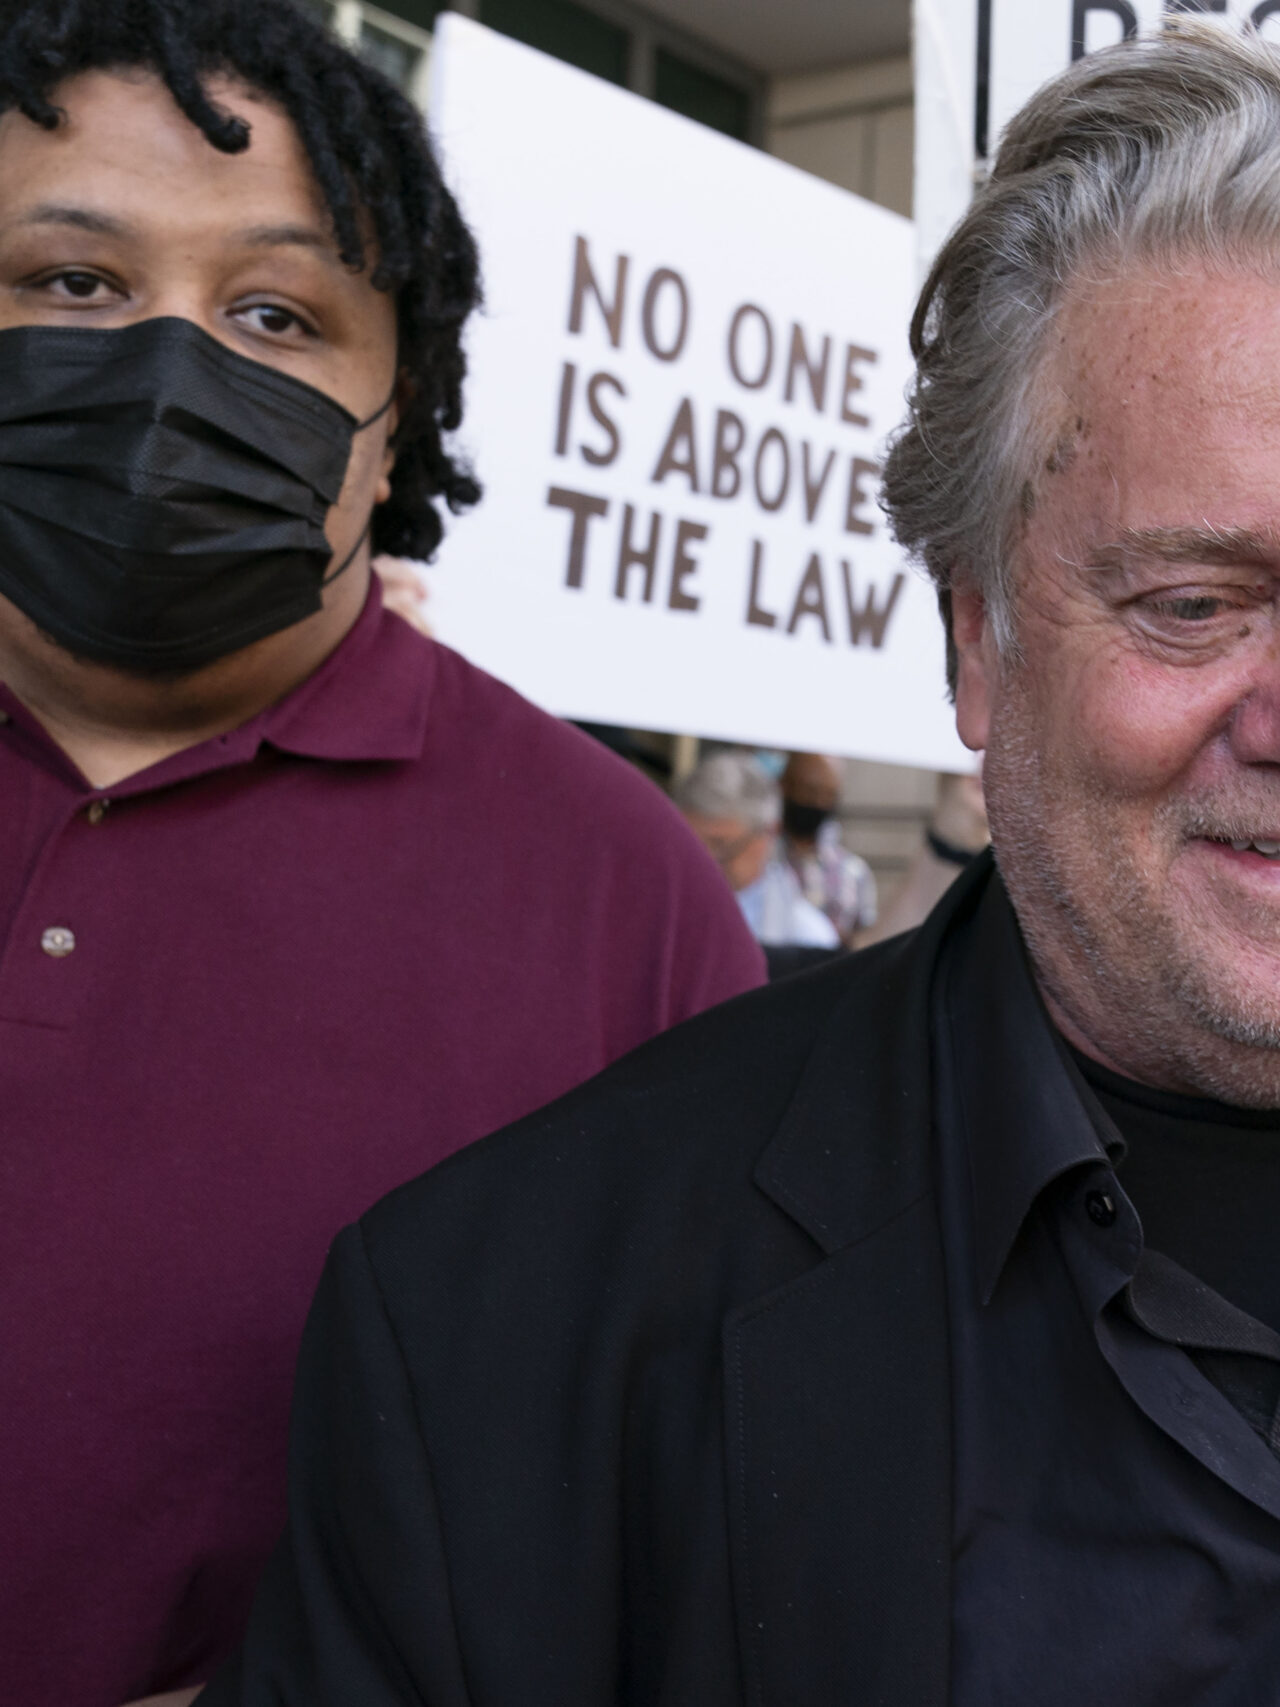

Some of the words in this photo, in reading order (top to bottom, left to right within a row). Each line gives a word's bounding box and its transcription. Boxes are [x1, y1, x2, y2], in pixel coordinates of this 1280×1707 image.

[566, 234, 691, 364] NO
[726, 302, 878, 428] ONE
[554, 361, 628, 468] IS
[650, 396, 881, 536] ABOVE
[545, 485, 709, 612] THE
[745, 537, 907, 650] LAW
